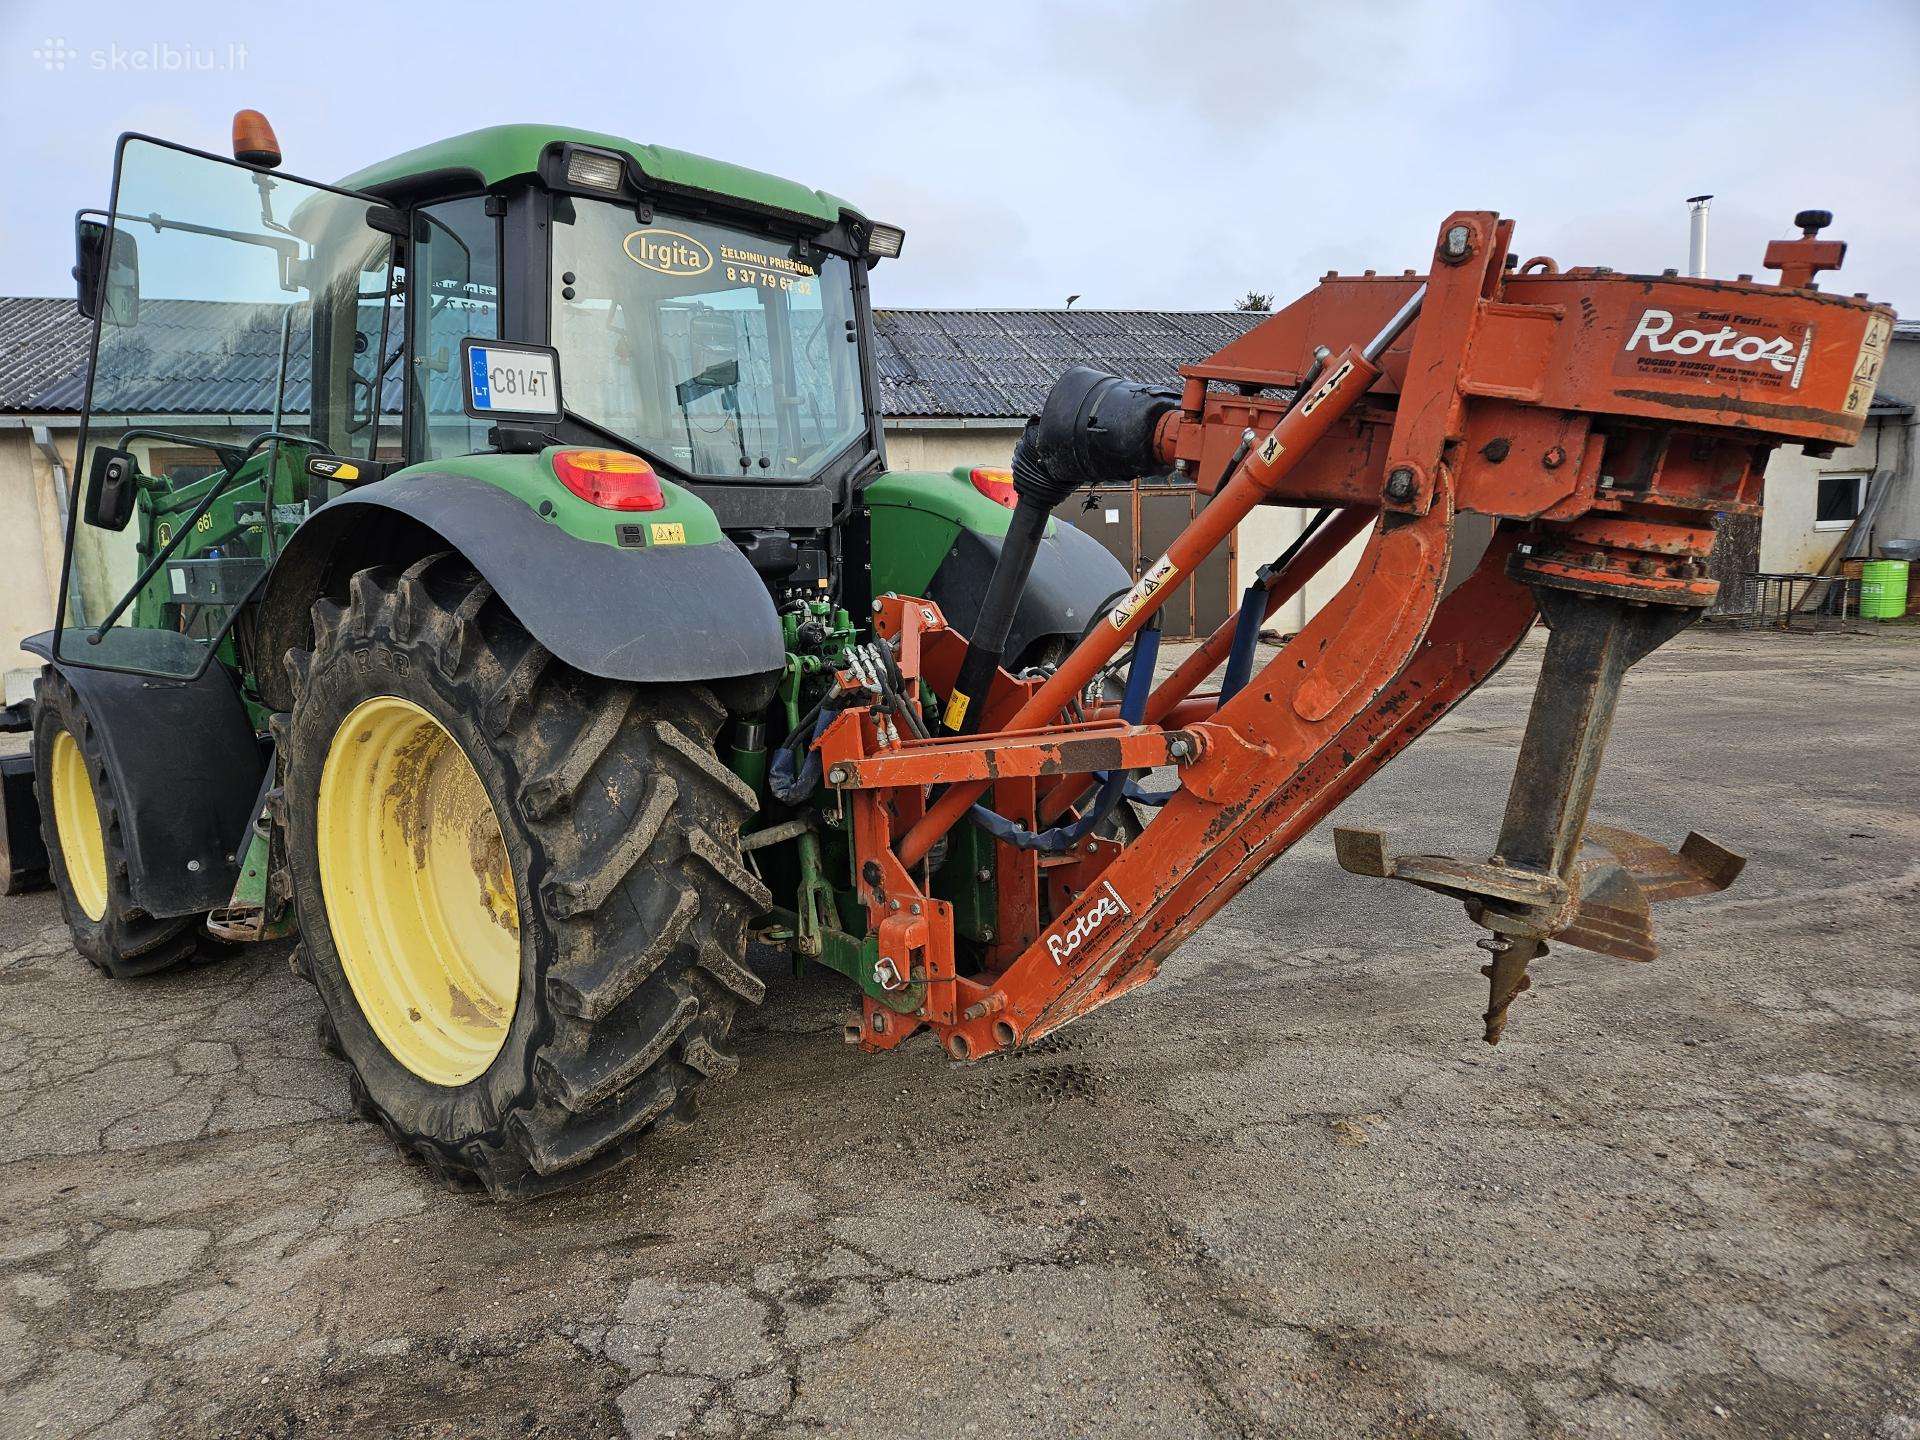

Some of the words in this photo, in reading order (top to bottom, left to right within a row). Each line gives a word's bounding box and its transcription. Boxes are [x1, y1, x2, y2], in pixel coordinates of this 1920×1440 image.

[639, 237, 701, 269] Irgita
[720, 244, 766, 266] ŽELDINIŲ
[726, 266, 736, 281] 8
[740, 269, 756, 284] 37
[760, 272, 776, 288] 79
[780, 276, 794, 291] 67
[474, 386, 488, 396] LT
[492, 367, 548, 397] C814T
[313, 462, 337, 473] SE
[197, 512, 213, 533] 661
